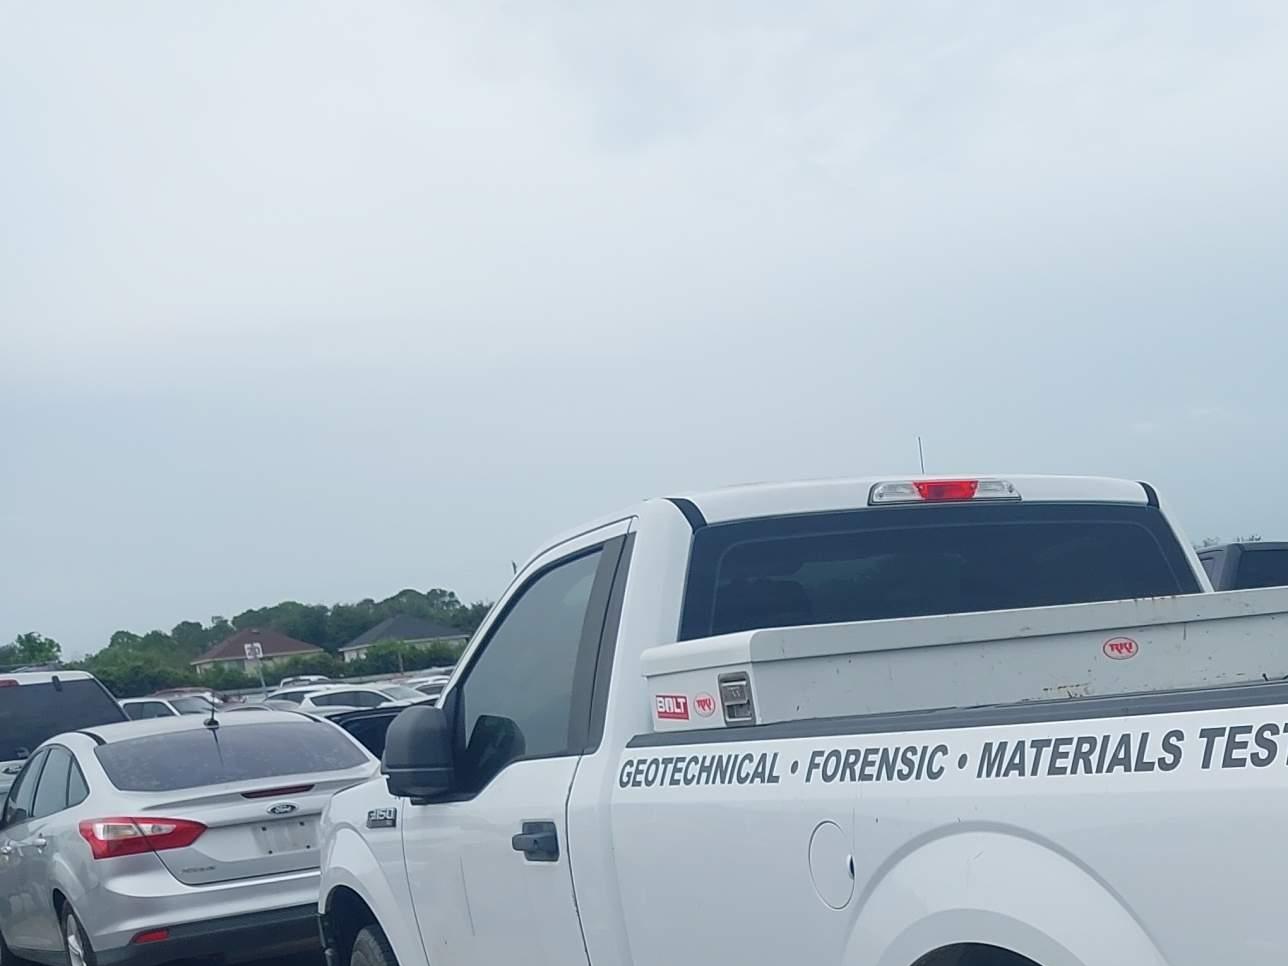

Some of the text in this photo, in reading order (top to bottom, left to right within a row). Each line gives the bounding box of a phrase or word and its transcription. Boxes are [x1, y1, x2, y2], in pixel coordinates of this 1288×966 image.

[656, 697, 687, 713] BOLT
[619, 752, 781, 788] GEOTECHNICAL
[805, 744, 949, 783] FORENSIC
[976, 729, 1185, 779] MATERIALS
